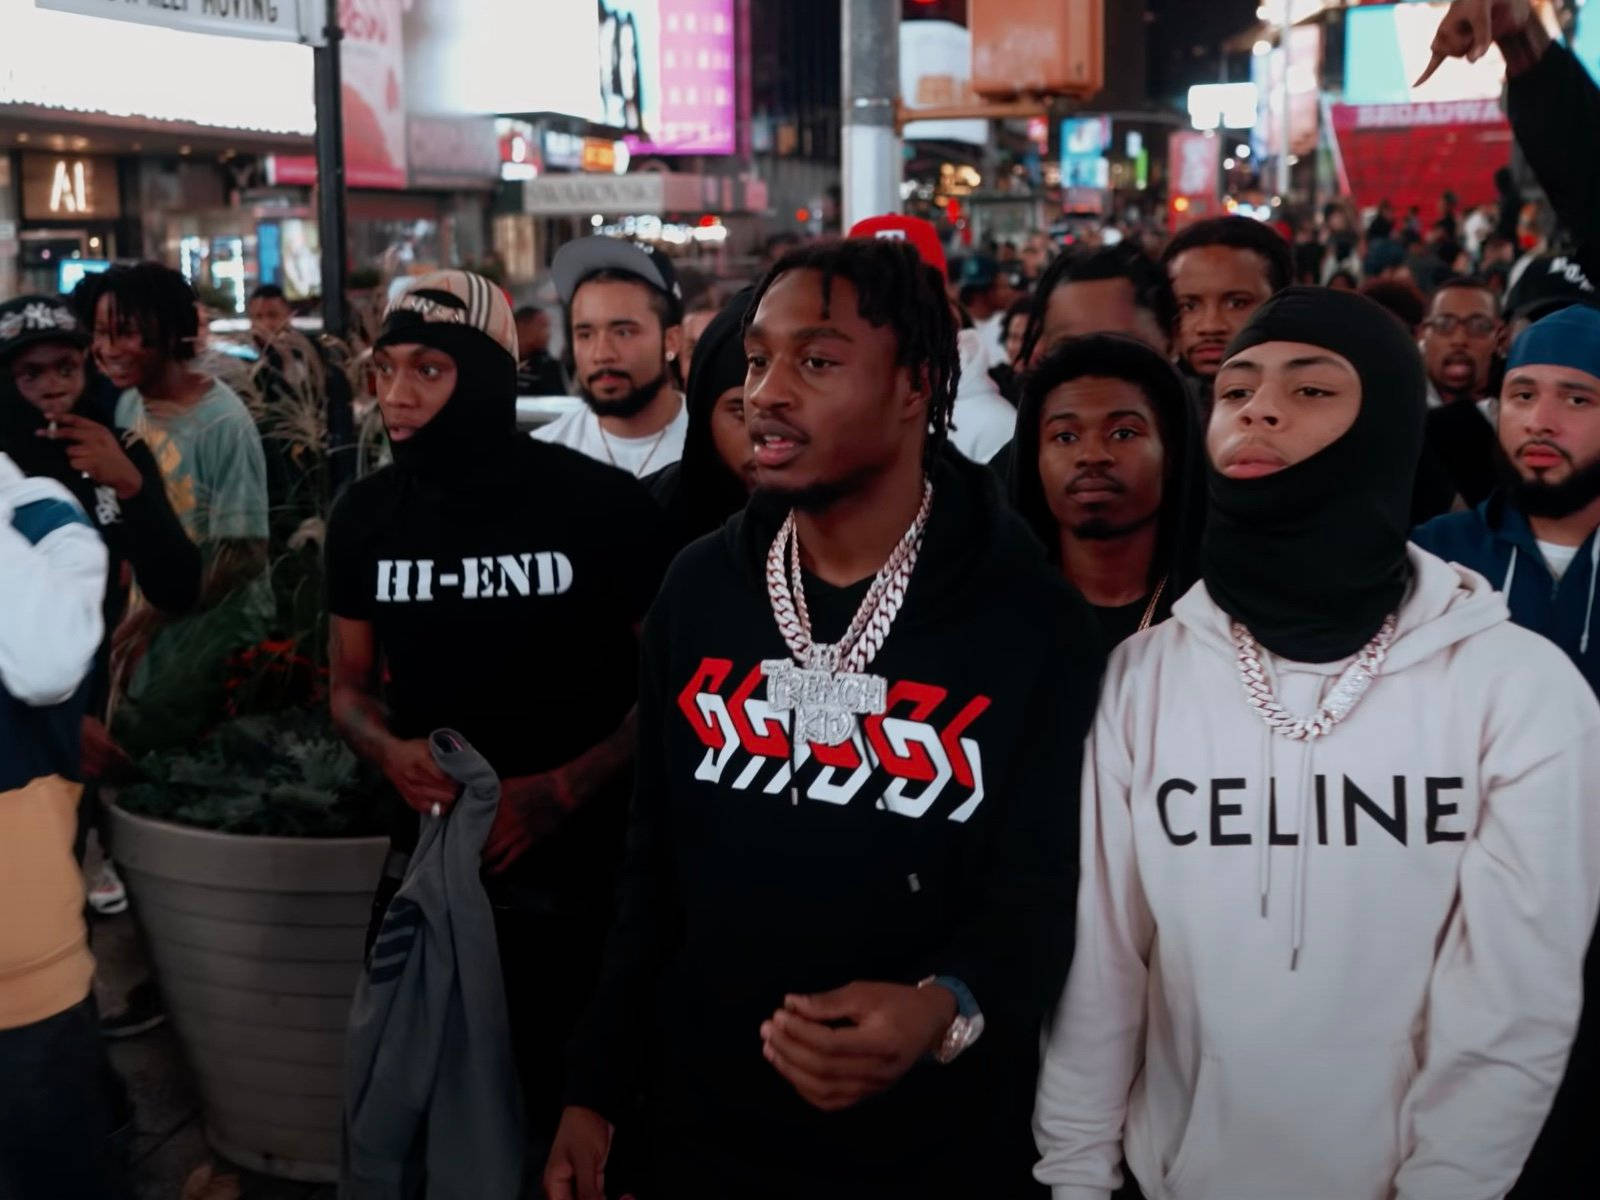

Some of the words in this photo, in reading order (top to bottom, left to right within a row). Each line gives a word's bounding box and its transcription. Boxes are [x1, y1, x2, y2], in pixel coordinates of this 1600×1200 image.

[1357, 102, 1507, 127] BROADWA
[376, 551, 573, 602] HI-END
[760, 657, 888, 716] TRENCH
[794, 703, 856, 747] KID
[1156, 774, 1467, 847] CELINE
